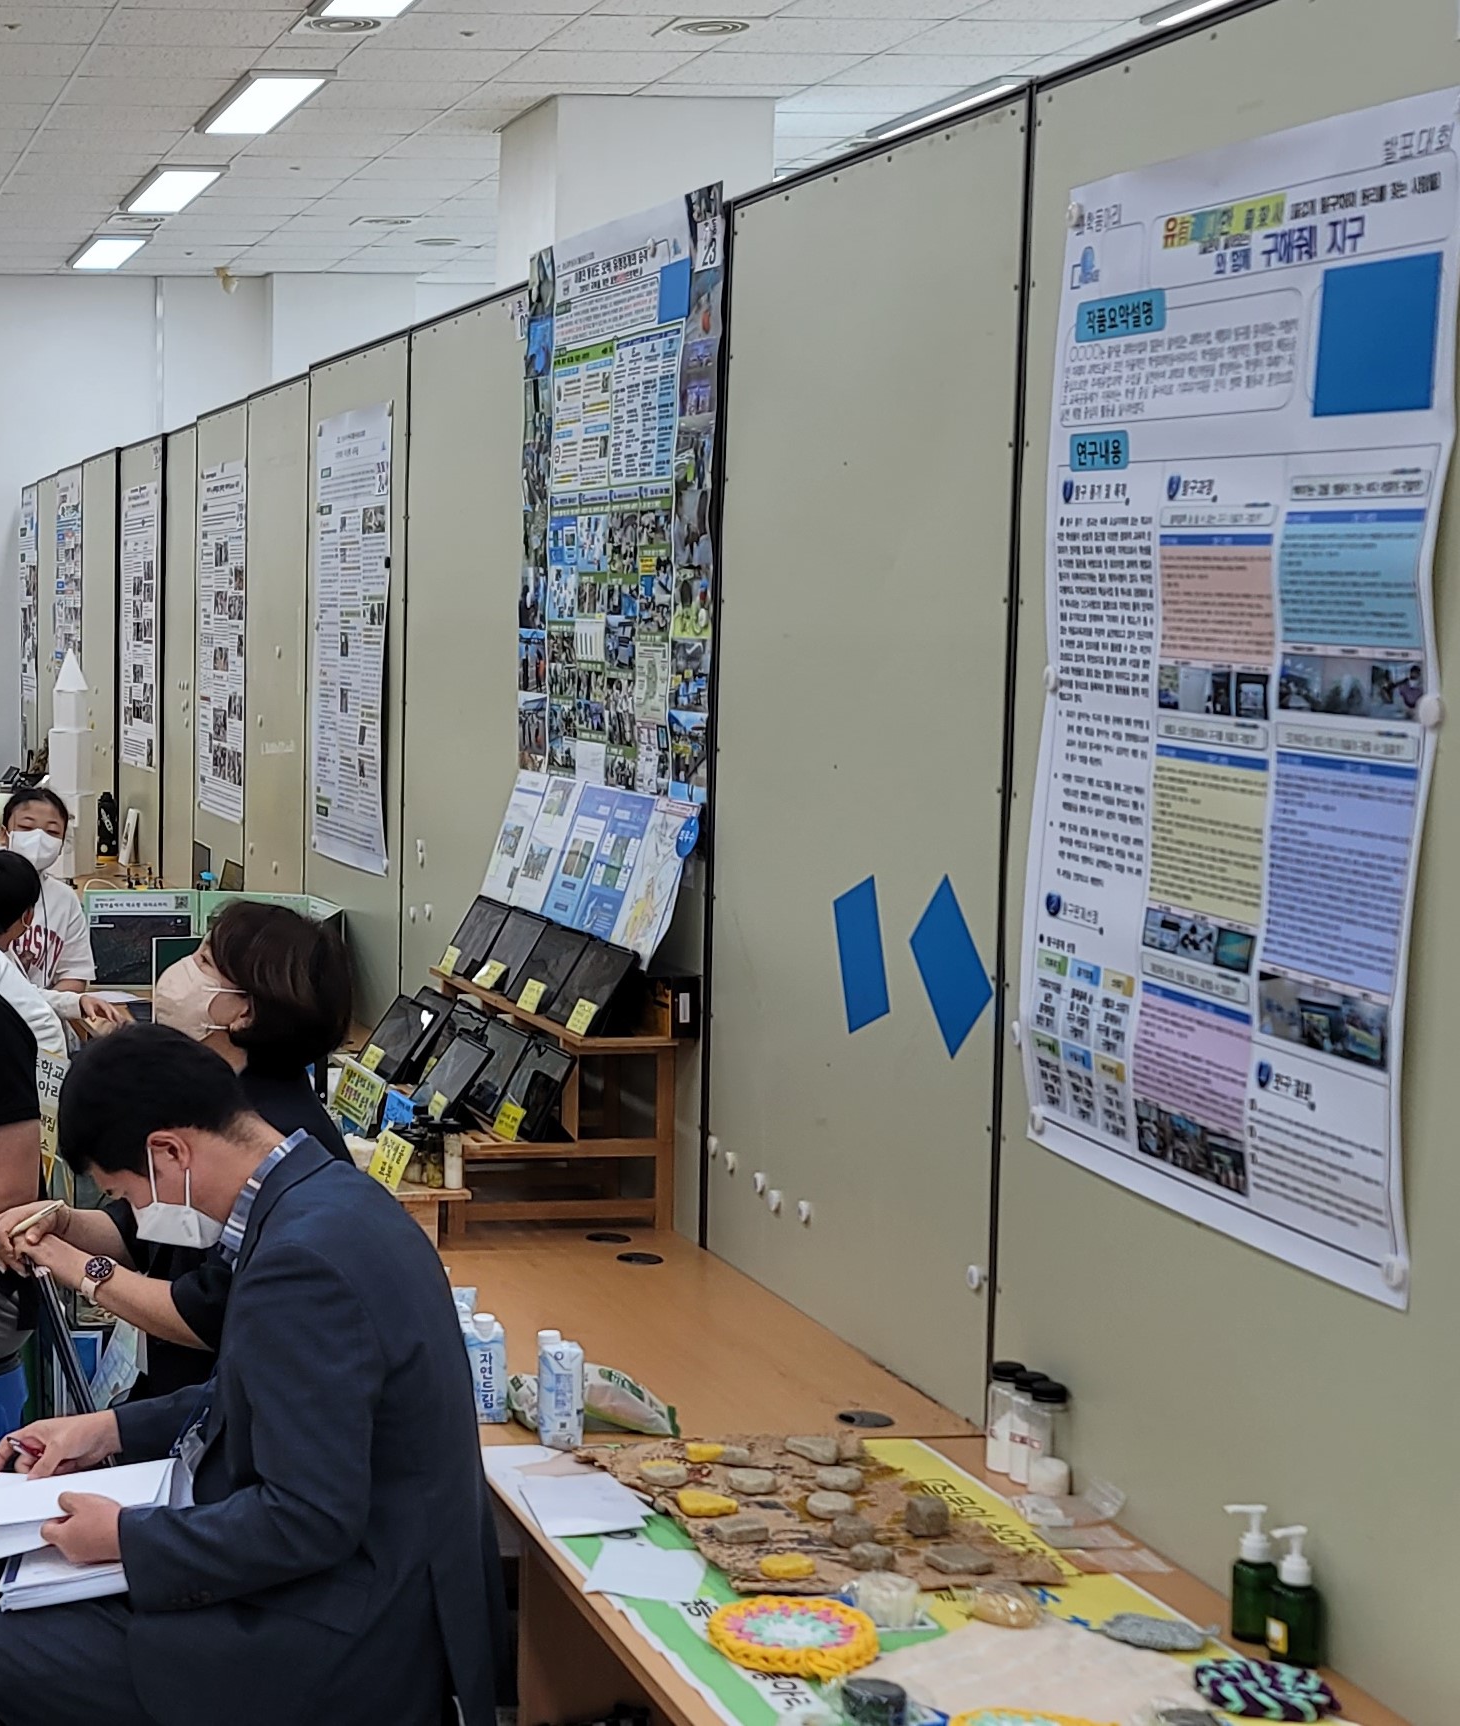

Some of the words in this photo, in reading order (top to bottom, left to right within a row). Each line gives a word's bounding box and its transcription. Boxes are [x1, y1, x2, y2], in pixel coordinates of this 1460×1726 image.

[701, 237, 717, 266] 23
[1326, 214, 1366, 255] 지구
[1086, 299, 1153, 335] 작품요약설명
[1076, 439, 1122, 466] 연구내용
[479, 1352, 494, 1409] 자연드림
